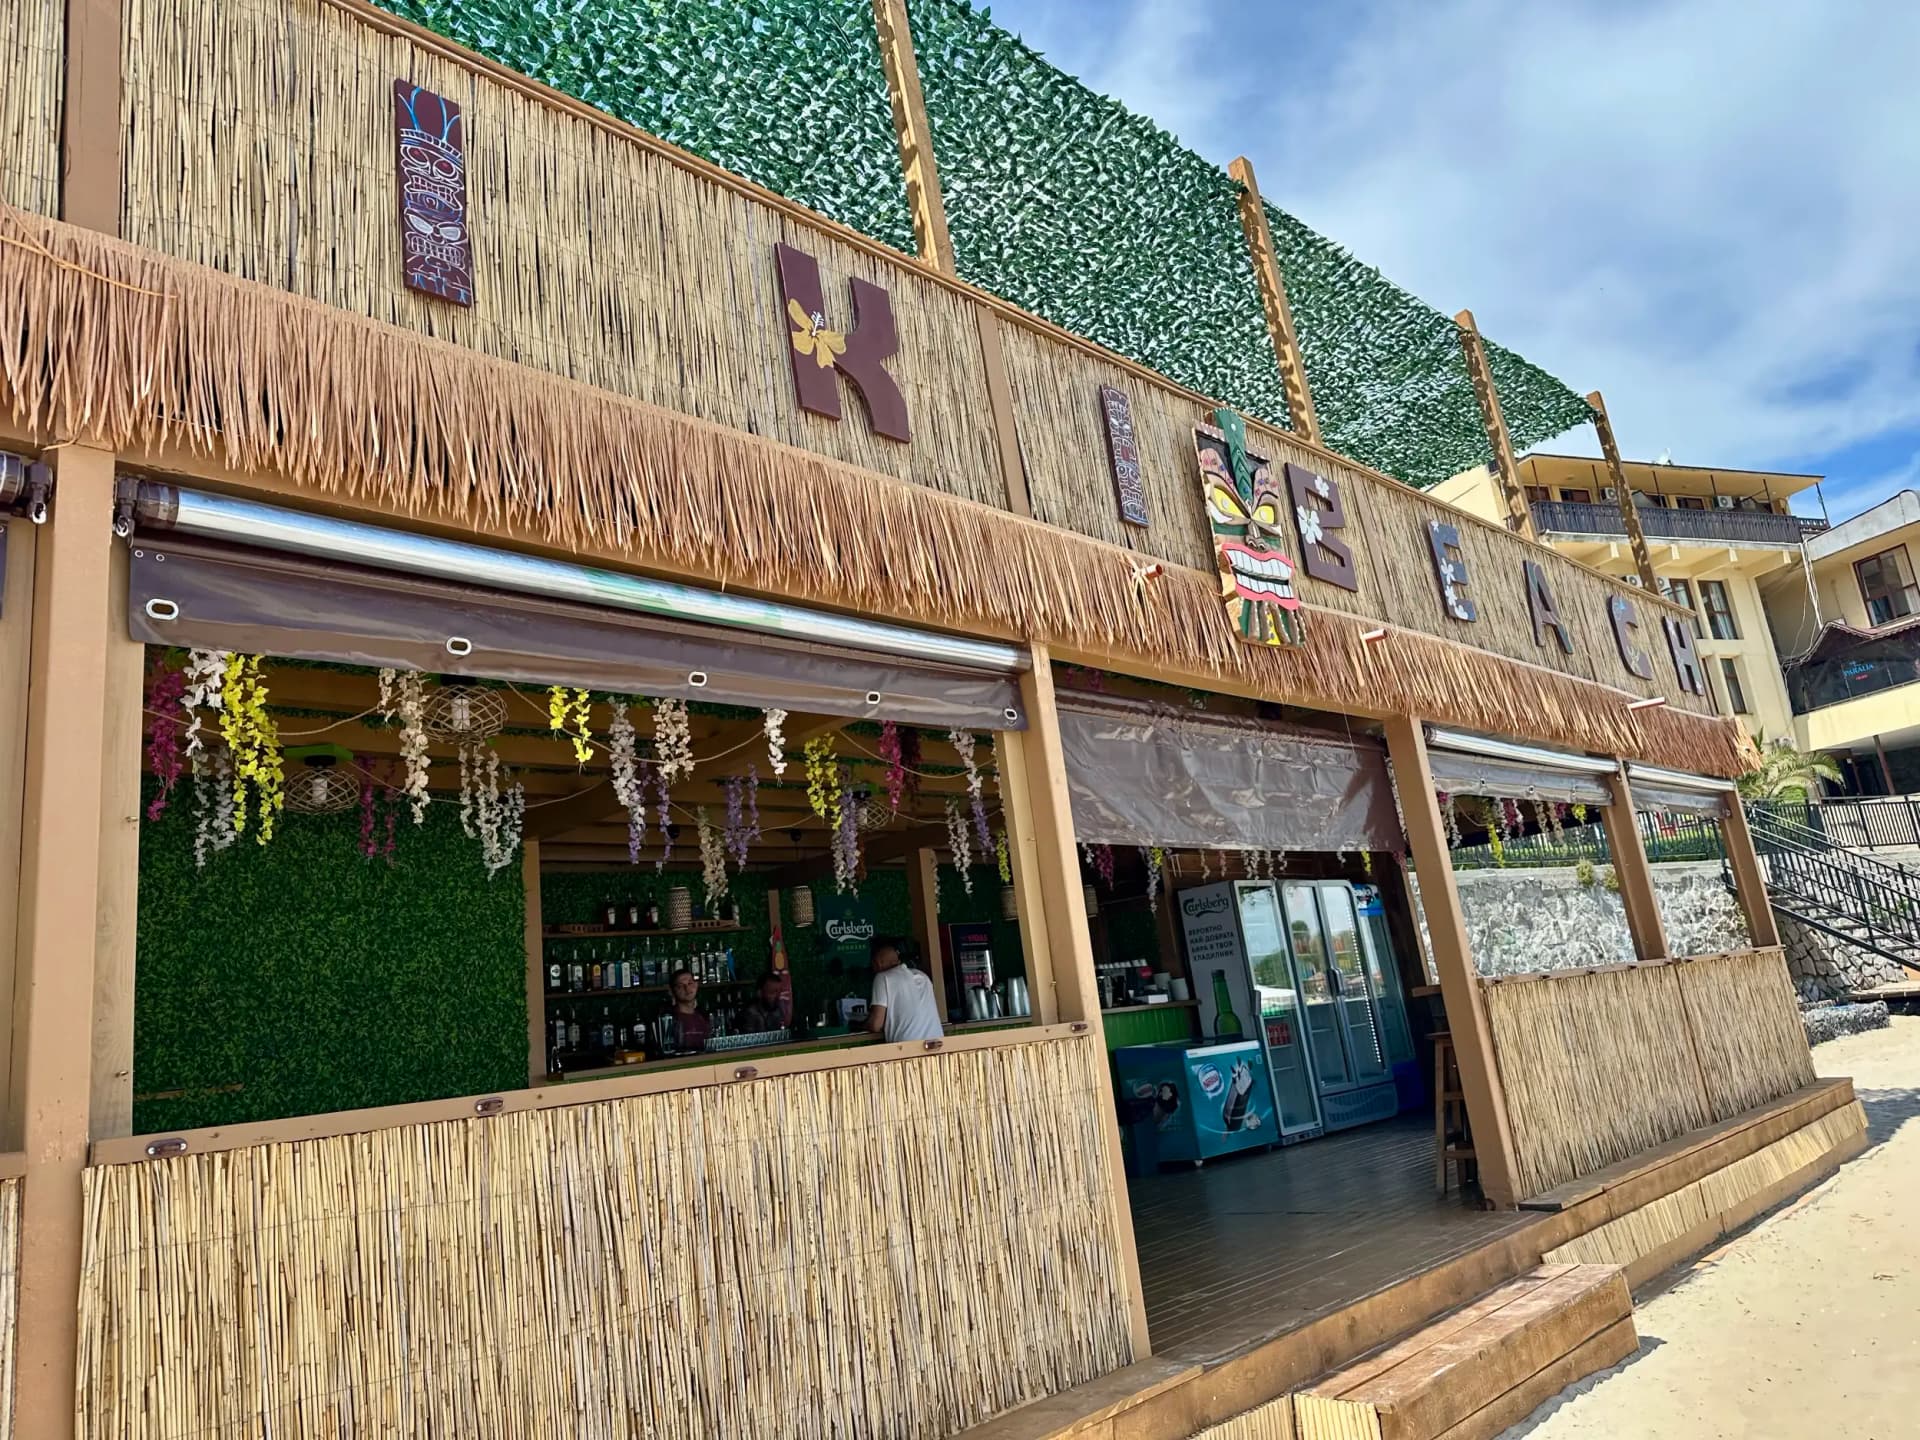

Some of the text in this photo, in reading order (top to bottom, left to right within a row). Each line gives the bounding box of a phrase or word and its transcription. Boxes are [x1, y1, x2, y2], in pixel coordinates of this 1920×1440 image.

[776, 242, 1705, 697] K BEACH
[1183, 893, 1229, 917] Carlsberg
[825, 918, 874, 942] Carlsberg
